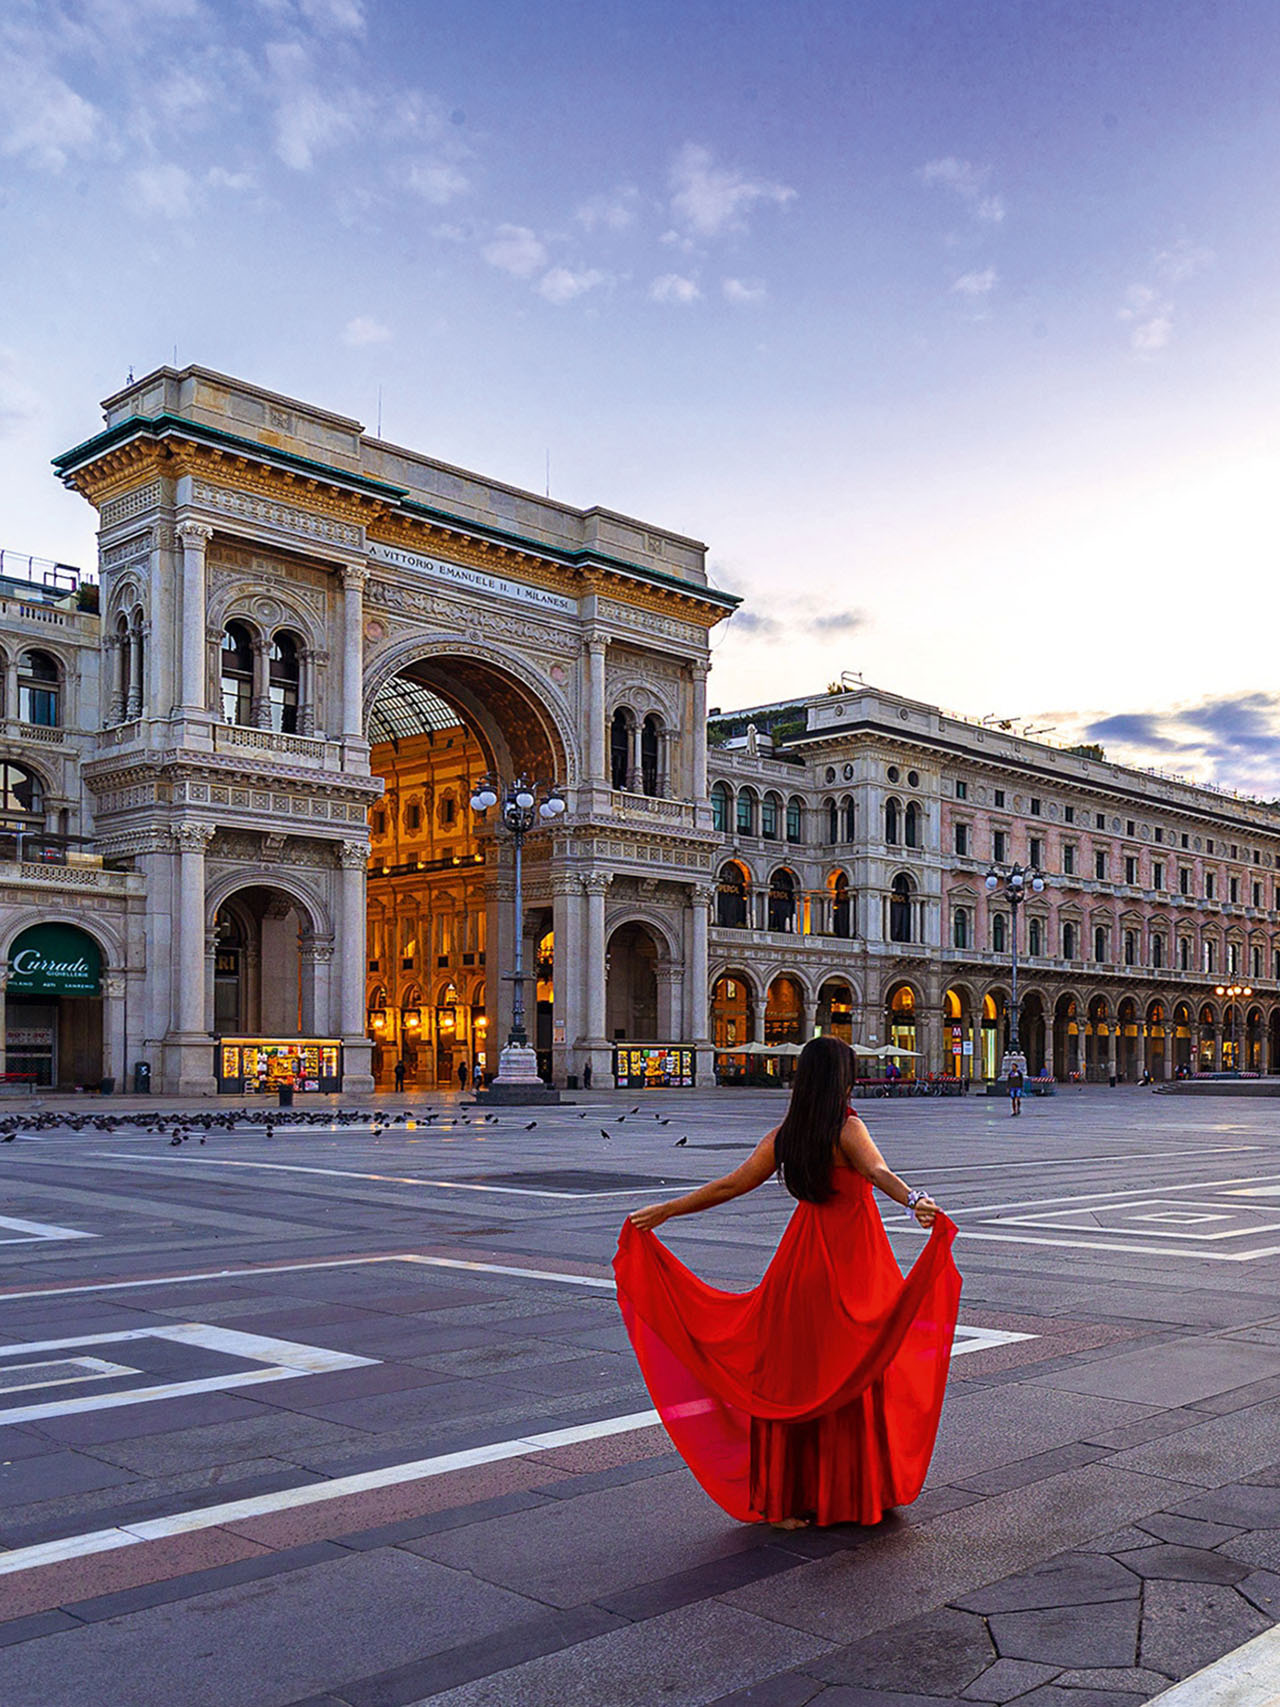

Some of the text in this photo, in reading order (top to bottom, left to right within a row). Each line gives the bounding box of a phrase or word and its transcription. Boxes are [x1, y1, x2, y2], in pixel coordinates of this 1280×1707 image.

[369, 546, 377, 555] A
[383, 549, 434, 571] VITTORIO
[439, 565, 495, 589] EMANUELE
[525, 590, 569, 609] MILANESI
[13, 949, 89, 975] Currado
